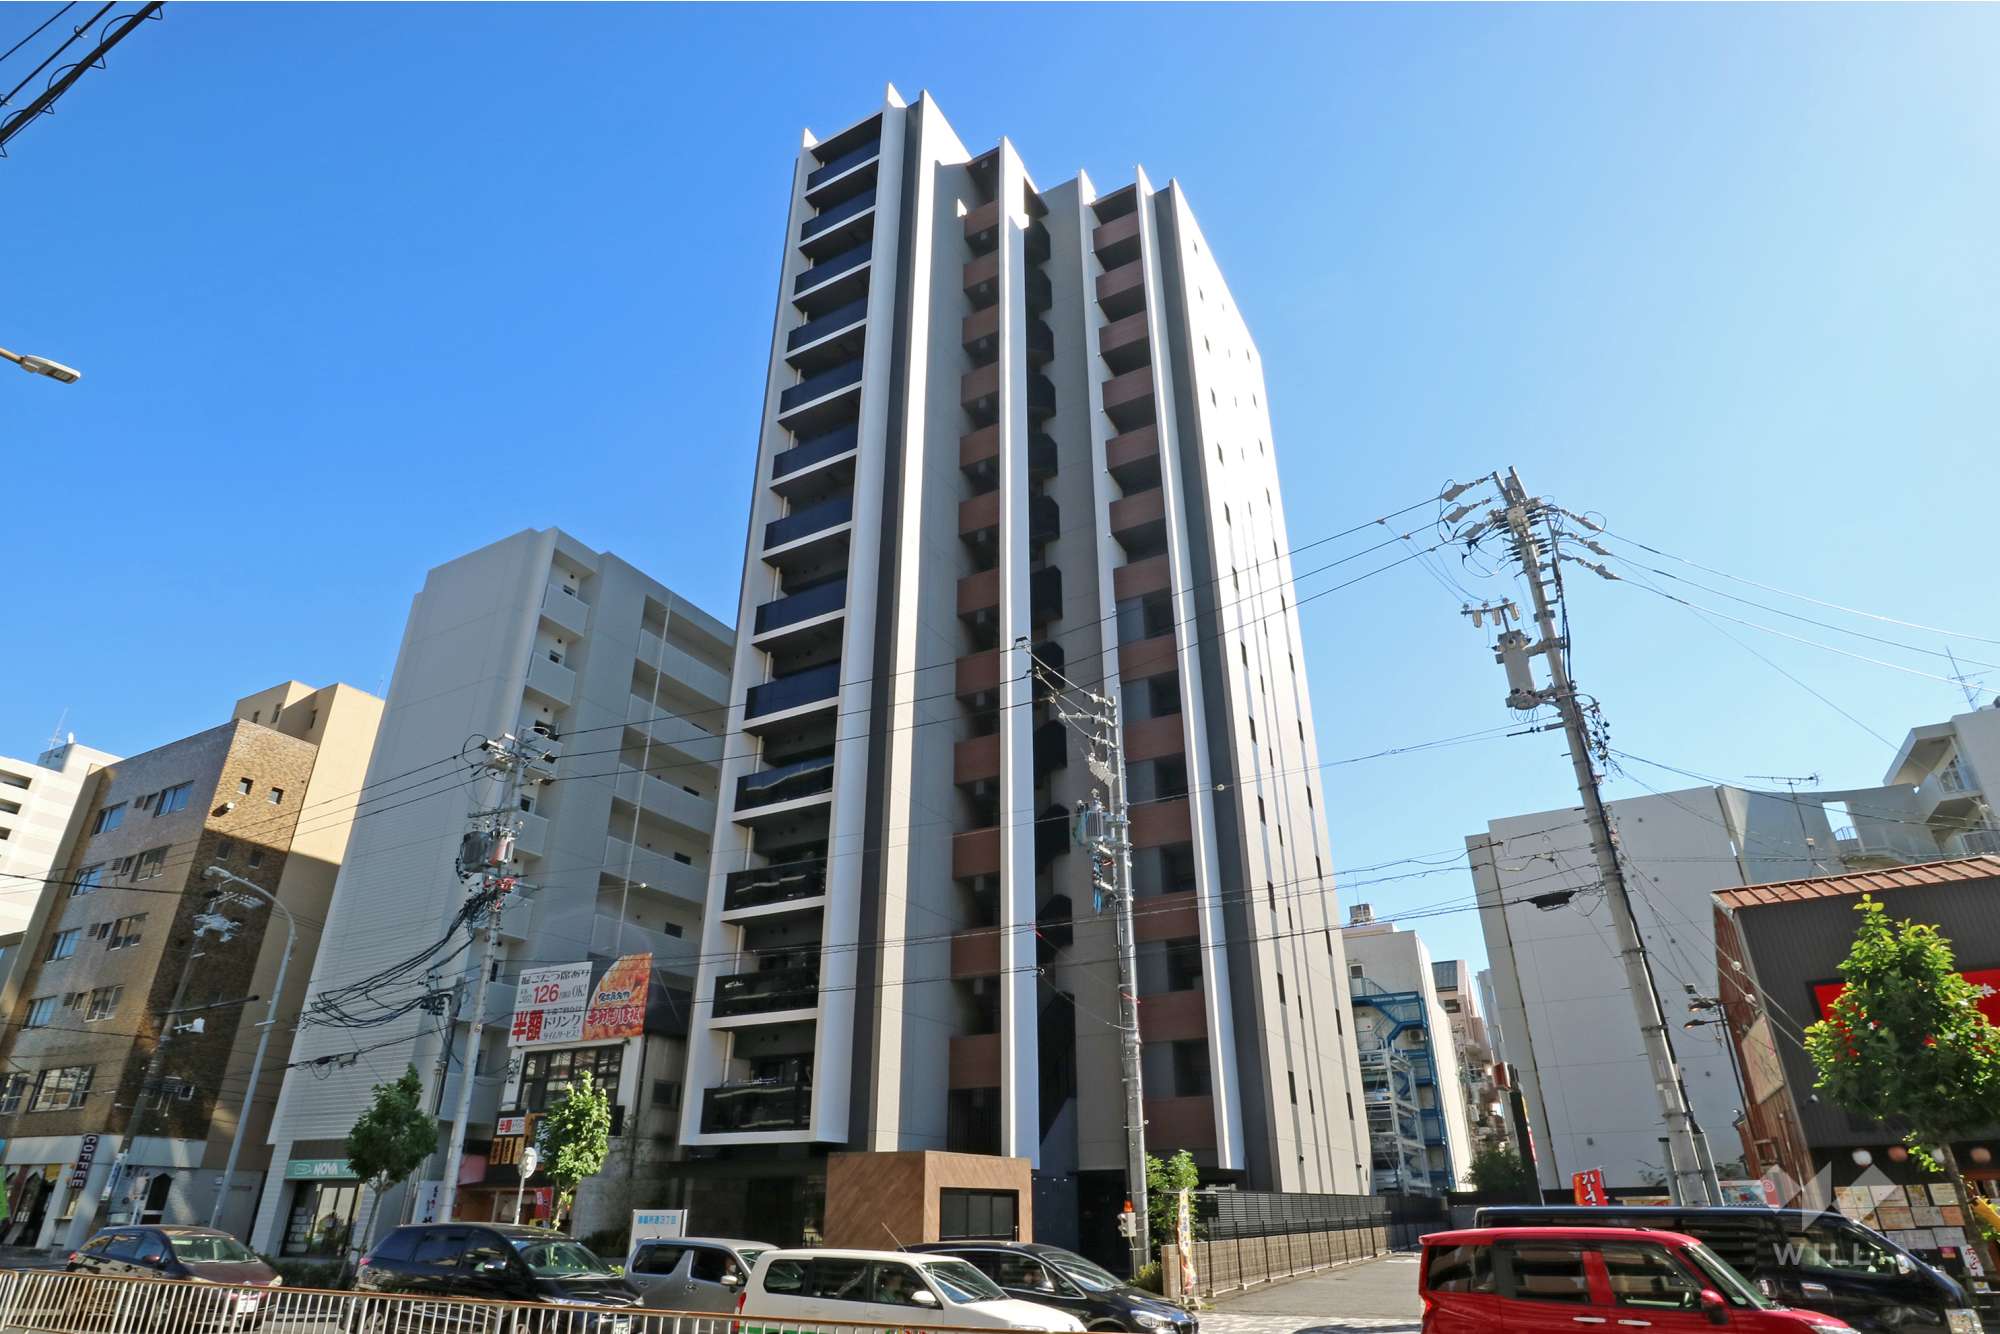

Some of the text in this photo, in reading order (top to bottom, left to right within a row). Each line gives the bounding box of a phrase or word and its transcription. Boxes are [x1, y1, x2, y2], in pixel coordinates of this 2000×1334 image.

[533, 984, 560, 1004] 126
[512, 1009, 544, 1042] 半額
[72, 1135, 97, 1187] COFFEE
[313, 1162, 338, 1176] NOVA
